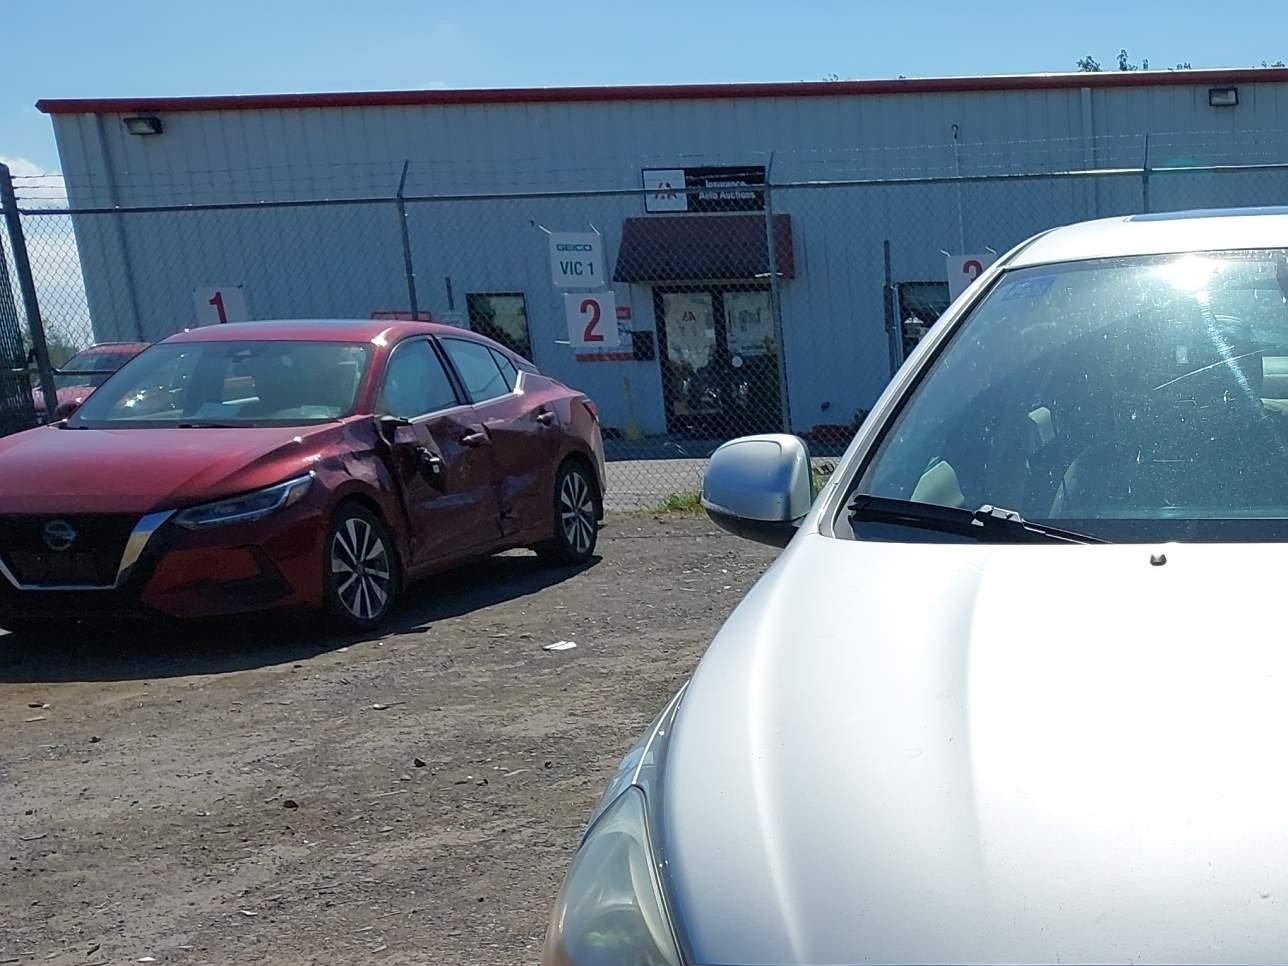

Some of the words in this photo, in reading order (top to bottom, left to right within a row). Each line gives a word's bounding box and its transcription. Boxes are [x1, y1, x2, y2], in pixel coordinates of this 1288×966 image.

[721, 190, 756, 200] Auctions
[556, 244, 592, 252] GEICO
[560, 261, 583, 275] VIC
[588, 262, 595, 275] 1
[208, 291, 227, 324] 1
[580, 299, 604, 342] 2
